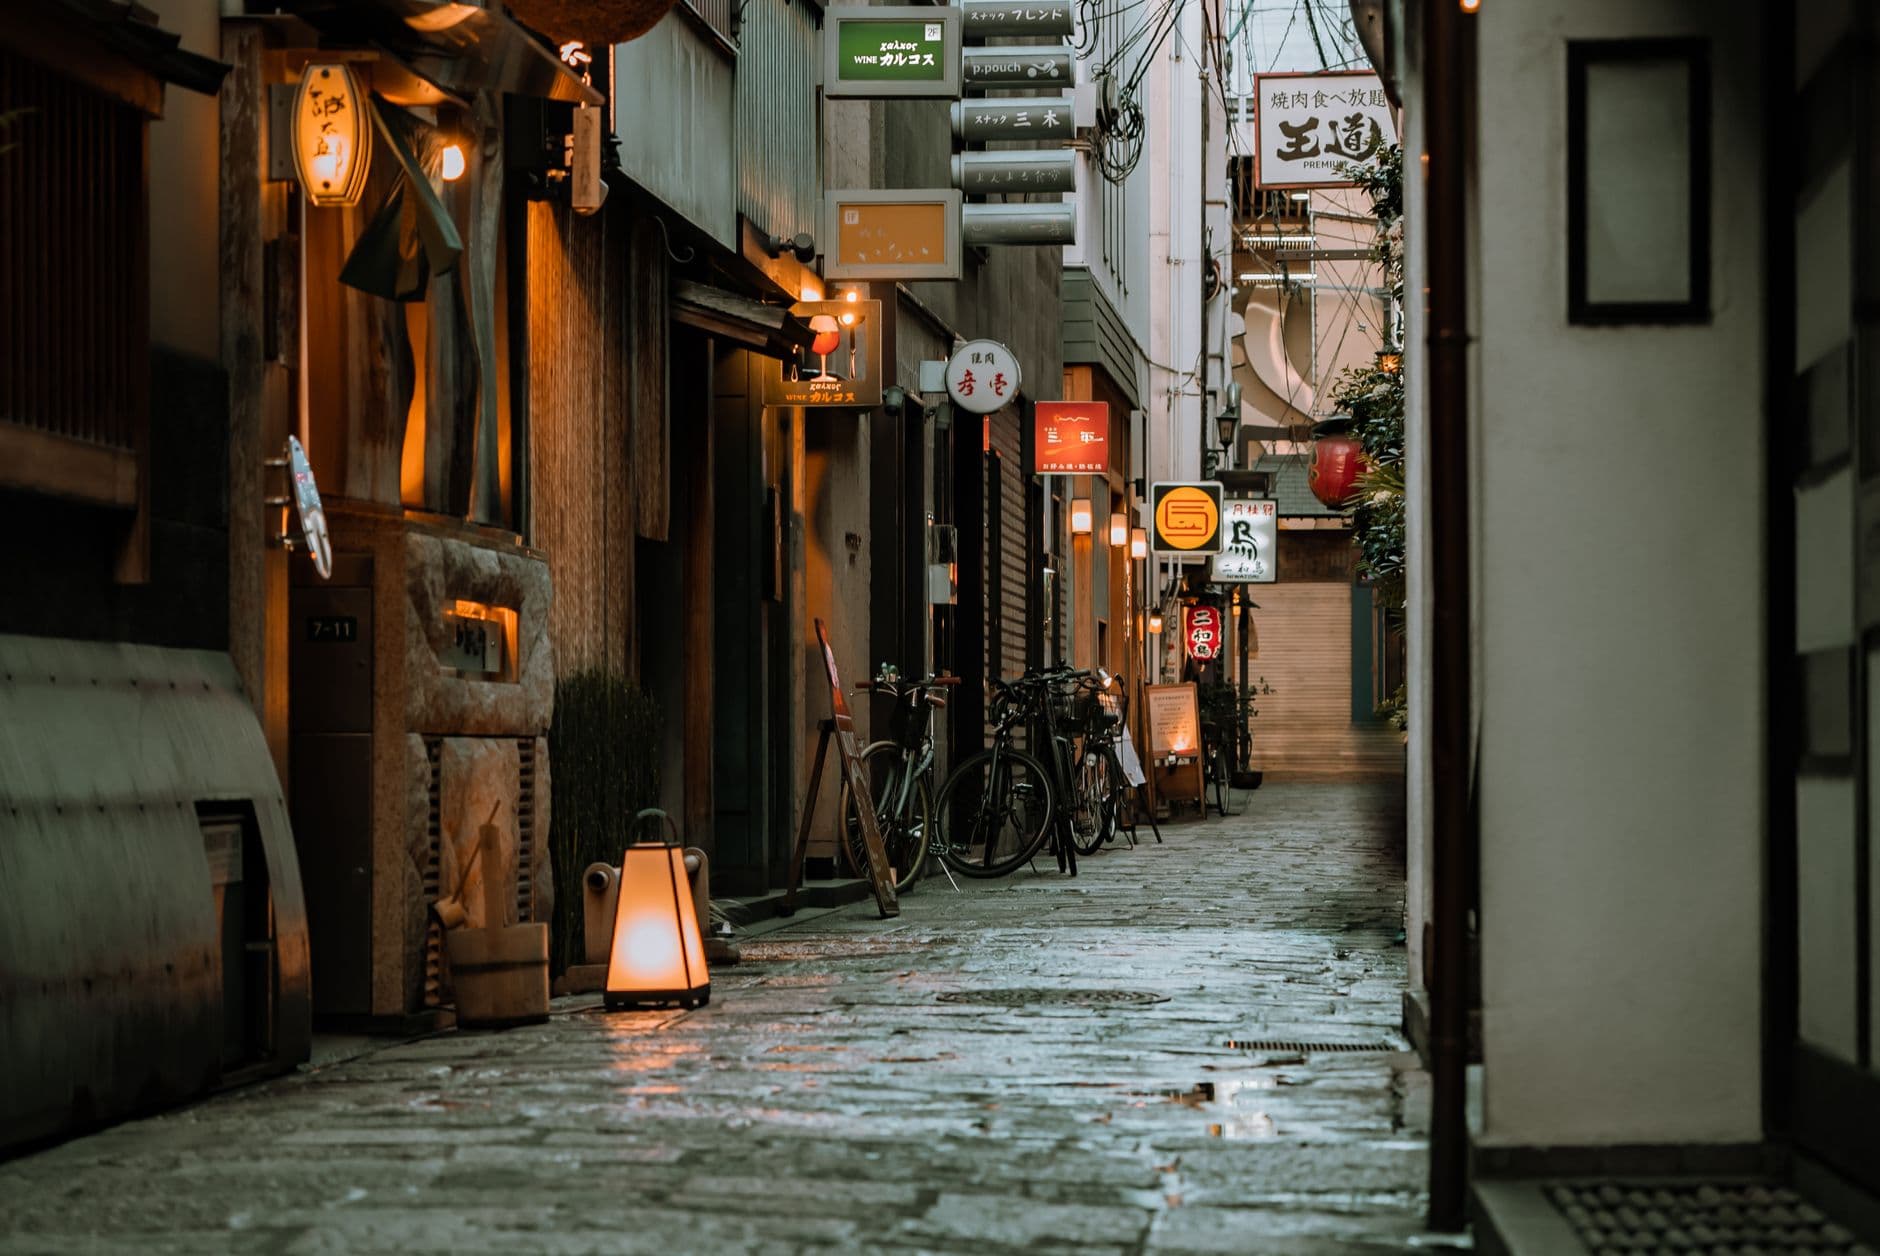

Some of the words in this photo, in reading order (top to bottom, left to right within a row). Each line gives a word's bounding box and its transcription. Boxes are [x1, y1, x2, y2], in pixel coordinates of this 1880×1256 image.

[970, 11, 1005, 20] スナック
[1012, 8, 1063, 21] フレンド
[927, 27, 939, 37] 2F
[854, 55, 878, 64] WINE
[880, 52, 935, 66] カルコス
[972, 62, 1021, 75] p.pouch
[1270, 88, 1387, 110] 焼肉食べ放題
[975, 114, 1007, 125] スナック
[1013, 109, 1061, 128] 三木
[1276, 112, 1382, 162] 王道
[809, 392, 856, 403] カルコス
[313, 621, 350, 637] 7-11
